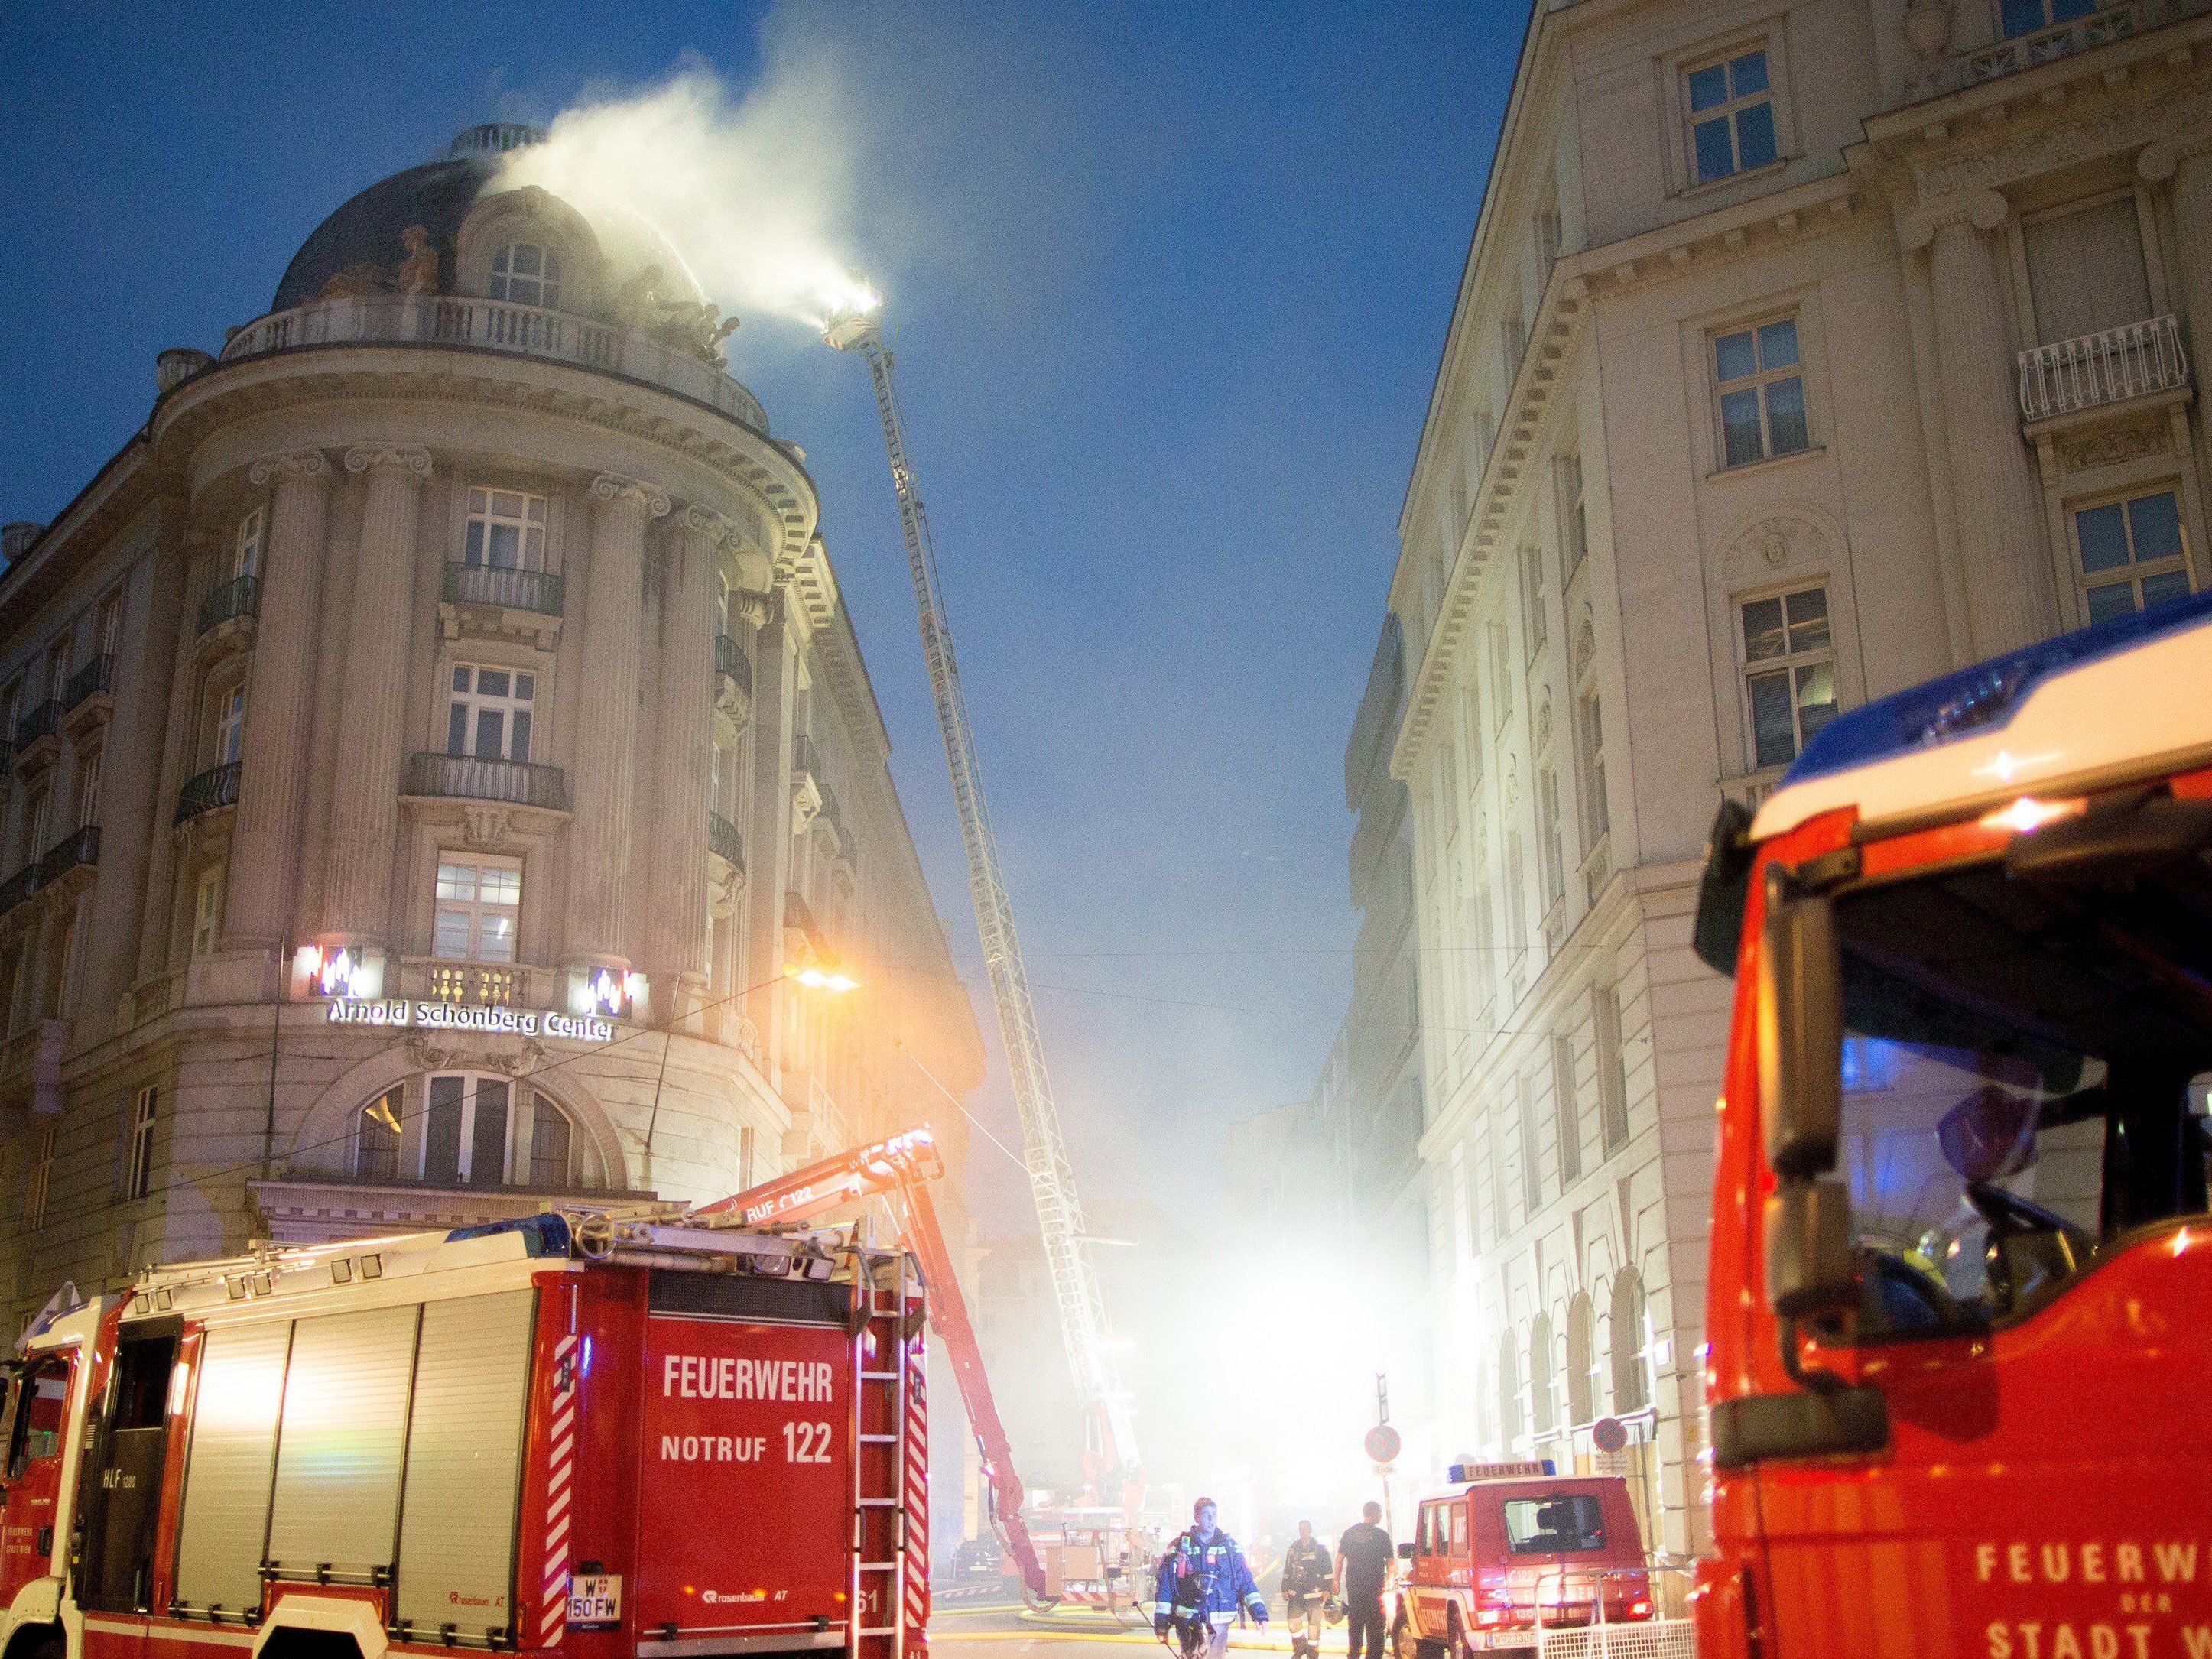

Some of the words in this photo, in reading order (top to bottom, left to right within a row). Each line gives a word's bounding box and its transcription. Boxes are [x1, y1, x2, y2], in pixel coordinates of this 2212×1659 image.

[326, 998, 408, 1024] Arnold
[415, 1002, 538, 1036] Schönberg
[545, 1011, 619, 1041] Center
[663, 1355, 833, 1403] FEUERWEHR
[661, 1435, 767, 1463] NOTRUF
[782, 1421, 833, 1463] 122
[102, 1469, 122, 1489] HLF
[1468, 1461, 1540, 1477] FEUERWEHR
[1976, 1543, 2212, 1583] FEUERW
[586, 1579, 596, 1598] W
[718, 1592, 765, 1602] rosenbauer
[774, 1590, 788, 1601] AT
[1986, 1621, 2151, 1659] STADT
